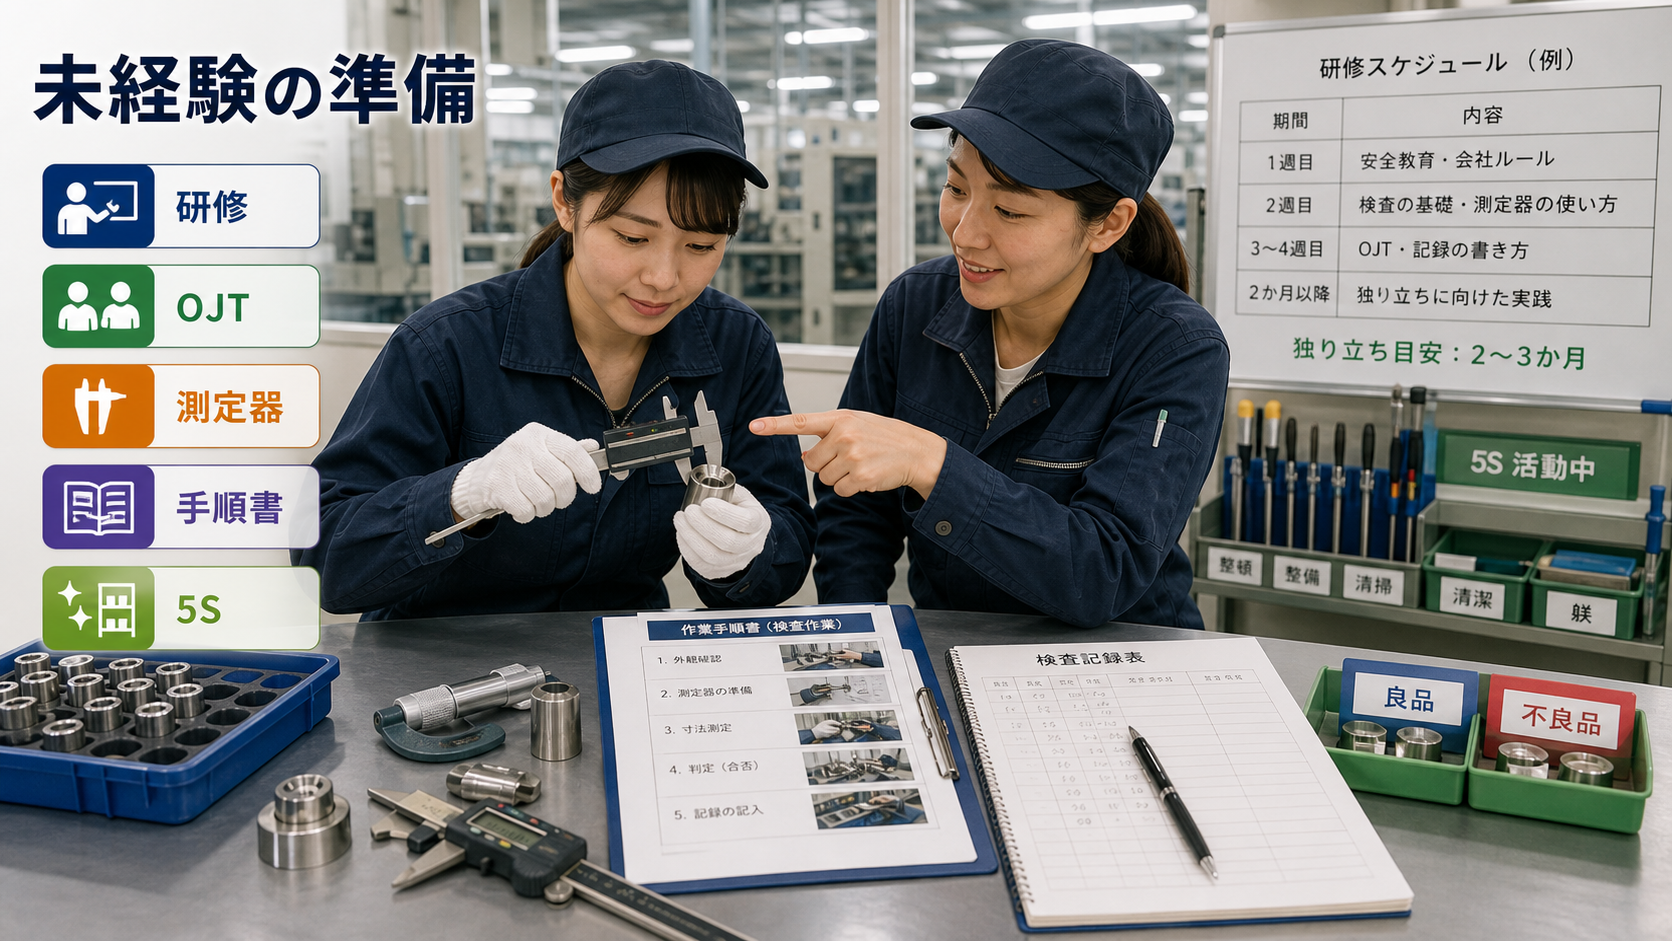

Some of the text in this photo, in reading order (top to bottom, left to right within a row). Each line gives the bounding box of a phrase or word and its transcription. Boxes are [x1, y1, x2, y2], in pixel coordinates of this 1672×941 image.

[1274, 112, 1307, 129] 期間
[1464, 105, 1502, 124] 内容
[1269, 154, 1312, 171] 1週目
[1267, 197, 1311, 213] 2週目
[1250, 285, 1329, 302] 2か月以降
[1358, 286, 1551, 308] 独り立ちに向けた実践
[1471, 450, 1595, 482] 5S 活動中
[1285, 566, 1320, 587] 整備
[1355, 574, 1393, 595] 清掃
[1453, 587, 1493, 610] 清潔
[1571, 603, 1593, 624] 躾
[1036, 651, 1146, 666] 検査記録表
[677, 686, 753, 698] 測定器の準備
[1384, 686, 1434, 712] 良品
[682, 722, 733, 735] 寸法測定
[1522, 704, 1601, 737] 不良品
[694, 804, 764, 820] 記録の記入
